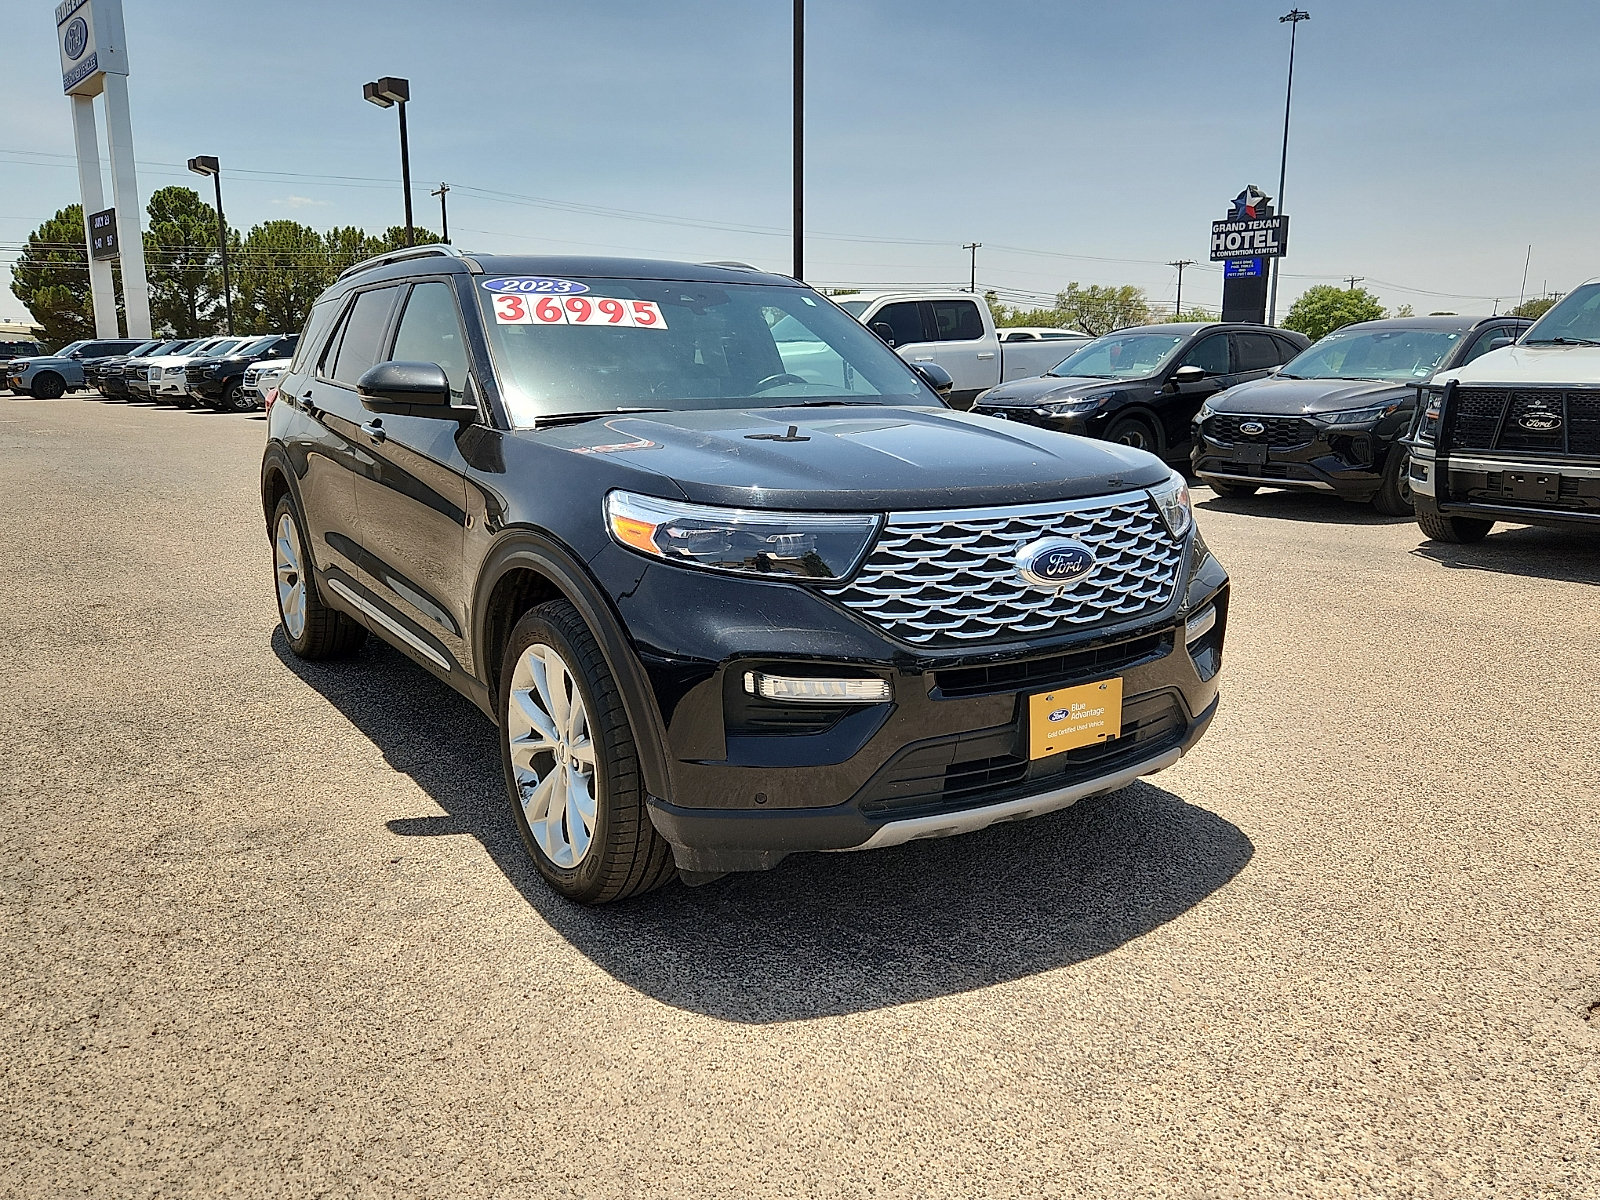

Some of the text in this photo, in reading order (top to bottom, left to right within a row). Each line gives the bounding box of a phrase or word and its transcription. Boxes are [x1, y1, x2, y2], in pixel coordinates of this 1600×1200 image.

[1213, 219, 1280, 232] GRAND TEXAN
[1212, 230, 1278, 250] HOTEL
[1216, 249, 1254, 257] CONVENTION
[501, 280, 573, 293] 2023
[497, 295, 657, 326] 36995
[1526, 418, 1553, 428] Ford
[1046, 552, 1083, 576] Ford
[1070, 707, 1105, 721] Advantage
[1071, 703, 1086, 712] Blue
[1047, 720, 1105, 739] Gold Certified Used Vehicle
